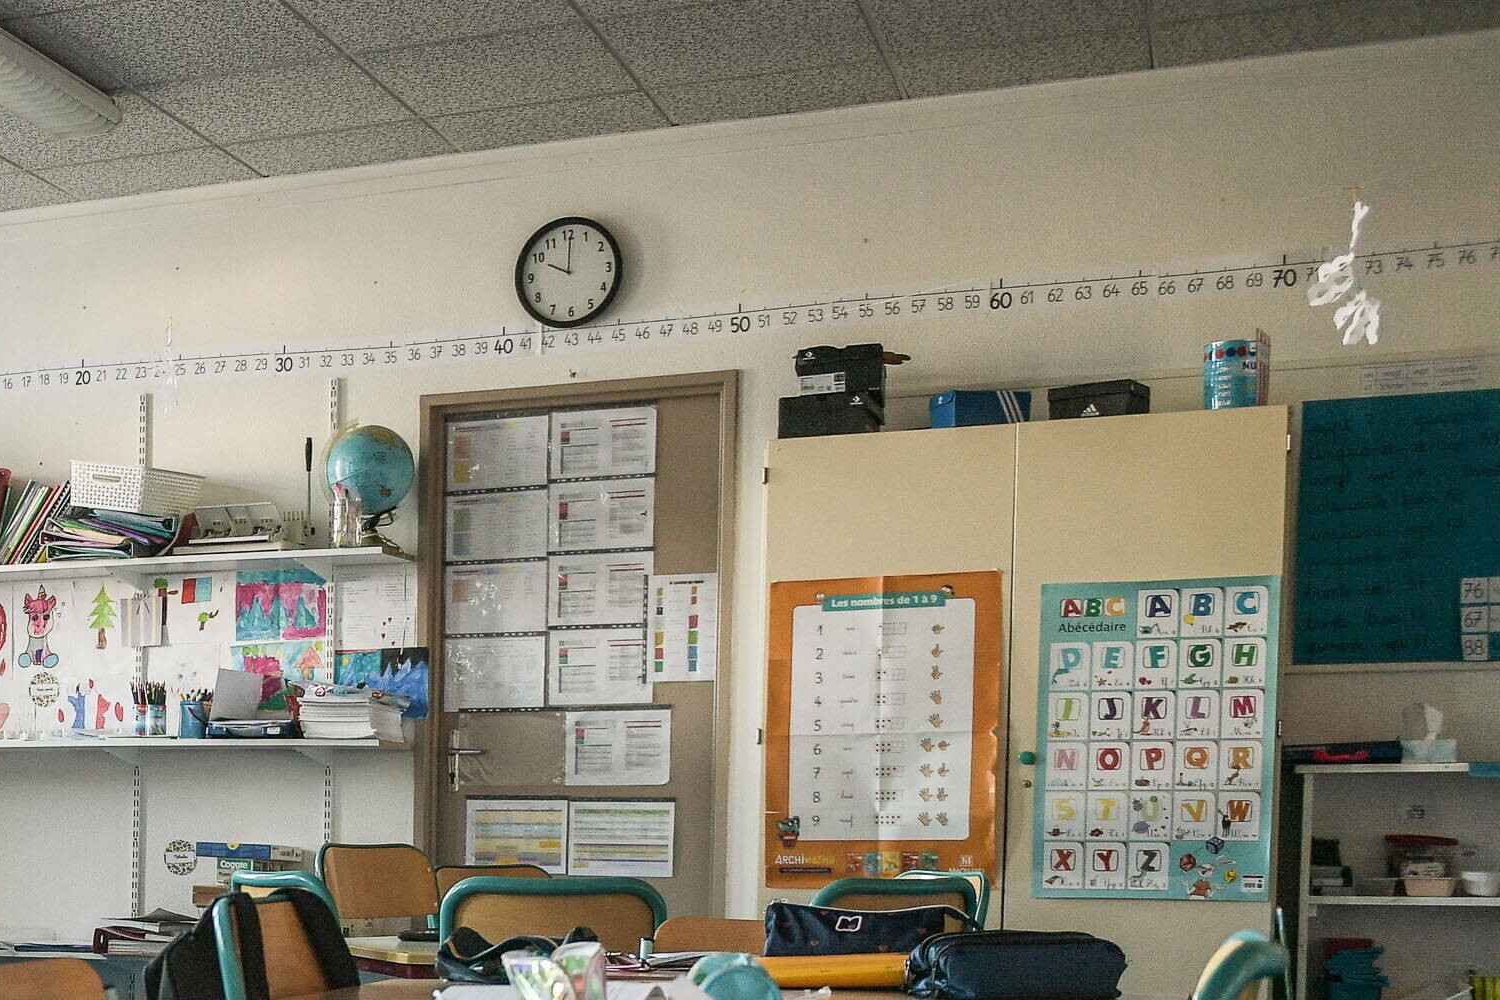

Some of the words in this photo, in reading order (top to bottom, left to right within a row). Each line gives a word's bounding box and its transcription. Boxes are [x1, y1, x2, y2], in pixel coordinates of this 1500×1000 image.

[562, 230, 574, 240] 12
[583, 232, 588, 242] 1
[545, 238, 556, 250] 11
[598, 241, 604, 252] 2
[532, 252, 544, 264] 10
[606, 262, 612, 272] 3
[528, 273, 534, 284] 9
[600, 282, 606, 292] 4
[534, 292, 542, 302] 8
[550, 304, 556, 316] 7
[588, 298, 594, 310] 5
[568, 306, 575, 318] 6
[4, 378, 13, 390] 16
[22, 376, 31, 387] 17
[40, 374, 50, 385] 18
[59, 372, 68, 384] 19
[76, 370, 91, 386] 20
[96, 370, 107, 382] 21
[116, 368, 127, 380] 22
[135, 367, 147, 378] 23
[174, 364, 186, 376] 25
[194, 362, 206, 374] 26
[214, 361, 226, 374] 27
[235, 360, 247, 372] 28
[256, 358, 268, 370] 29
[276, 357, 292, 372] 30
[299, 357, 310, 368] 31
[320, 355, 332, 367] 32
[341, 354, 354, 366] 33
[362, 352, 375, 365] 34
[384, 351, 396, 364] 35
[408, 348, 421, 360] 36
[430, 346, 442, 358] 37
[452, 344, 466, 356] 38
[474, 342, 488, 354] 39
[494, 338, 513, 354] 40
[520, 337, 532, 349] 41
[542, 336, 554, 348] 42
[564, 333, 578, 346] 43
[588, 331, 602, 343] 44
[612, 329, 626, 342] 45
[635, 327, 650, 339] 46
[660, 324, 674, 336] 47
[683, 322, 698, 335] 48
[708, 320, 722, 332] 49
[730, 316, 750, 332] 50
[758, 315, 770, 328] 51
[783, 312, 798, 325] 52
[808, 309, 823, 322] 53
[832, 306, 848, 320] 54
[859, 304, 874, 317] 55
[885, 302, 900, 315] 56
[911, 300, 926, 312] 57
[938, 298, 954, 310] 58
[965, 296, 980, 308] 59
[990, 292, 1012, 310] 60
[1020, 291, 1034, 304] 61
[1048, 288, 1063, 302] 62
[1075, 286, 1092, 300] 63
[1102, 284, 1120, 298] 64
[1132, 282, 1148, 295] 65
[1158, 281, 1175, 295] 66
[1188, 278, 1204, 292] 67
[1216, 276, 1234, 290] 68
[1246, 273, 1264, 287] 69
[1273, 269, 1296, 288] 70
[1366, 260, 1382, 274] 73
[1396, 257, 1413, 271] 74
[1427, 253, 1444, 268] 75
[1459, 250, 1477, 264] 76
[1464, 583, 1483, 600] 76
[832, 599, 848, 608] Les
[850, 598, 894, 608] nombres
[897, 596, 910, 605] de
[913, 595, 918, 604] 1
[921, 594, 930, 604] à
[931, 594, 938, 604] 9
[1062, 597, 1124, 617] ABC
[1150, 594, 1171, 617] A
[1193, 593, 1214, 616] B
[1236, 592, 1257, 614] C
[1464, 612, 1482, 628] 67
[816, 624, 823, 636] 1
[1058, 621, 1126, 633] Abécédaire
[815, 648, 824, 660] 2
[1061, 648, 1082, 668] D
[1104, 647, 1122, 668] E
[1150, 646, 1166, 668] F
[1190, 644, 1212, 667] G
[1234, 644, 1256, 666] H
[815, 672, 824, 684] 3
[814, 696, 822, 708] 4
[1062, 698, 1073, 720] I
[1104, 698, 1117, 720] J
[1144, 697, 1164, 720] K
[1192, 696, 1206, 718] L
[1232, 696, 1255, 718] M
[814, 719, 822, 732] 5
[813, 743, 822, 756] 6
[1056, 748, 1078, 770] N
[1099, 748, 1120, 770] O
[1146, 748, 1162, 770] P
[1186, 747, 1208, 769] Q
[1230, 747, 1252, 769] R
[812, 766, 821, 780] 7
[813, 791, 821, 804] 8
[1055, 798, 1076, 820] S
[1097, 798, 1116, 820] T
[1141, 800, 1161, 822] U
[1182, 800, 1206, 822] V
[1228, 800, 1252, 822] W
[812, 814, 820, 828] 9
[1054, 850, 1074, 871] X
[1097, 850, 1114, 871] Y
[1142, 850, 1156, 872] Z
